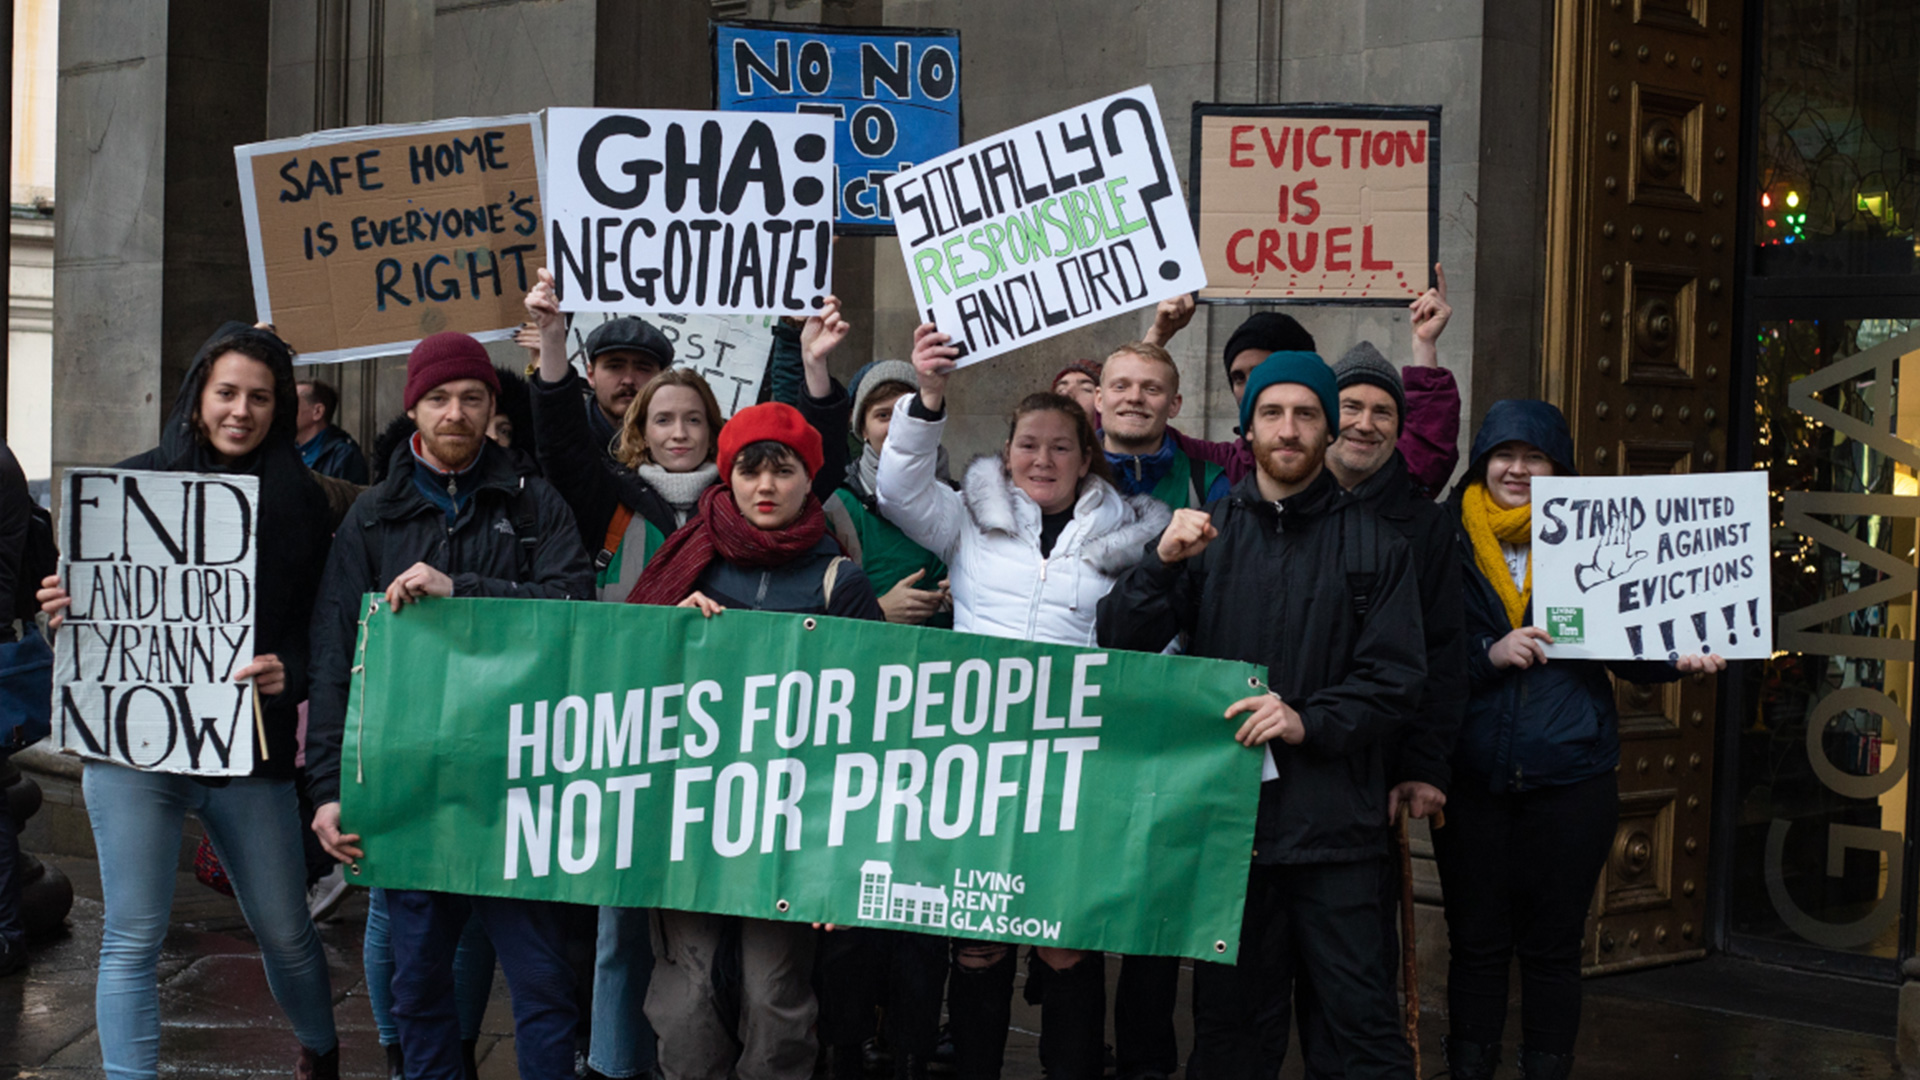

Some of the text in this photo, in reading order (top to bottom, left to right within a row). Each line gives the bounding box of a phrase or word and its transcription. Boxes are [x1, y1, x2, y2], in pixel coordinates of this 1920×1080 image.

[733, 39, 955, 100] NO NO
[279, 131, 509, 202] SAFE HOME
[577, 115, 827, 215] GHA:
[895, 113, 1105, 247] SOCIALLY
[1229, 125, 1426, 172] EVICTION
[303, 191, 538, 260] IS EVERYONE'S
[1278, 178, 1320, 225] IS
[552, 217, 830, 310] NEGOTIATE!
[914, 176, 1147, 305] RESPONSIBLE
[375, 243, 537, 310] RIGHT
[69, 474, 250, 565] END
[1539, 496, 1734, 545] STAND UNITED
[1657, 522, 1751, 564] AGAINST
[64, 564, 250, 624] LANDLORD
[1618, 555, 1753, 613] EVICTIONS
[60, 623, 251, 684] TYRANNY
[60, 683, 248, 769] NOW
[507, 652, 1109, 780] HOMES FOR PEOPLE
[503, 735, 1099, 880] NOT FOR PROFIT
[952, 889, 1013, 913] RENT
[954, 868, 1025, 894] LIVING
[950, 911, 1062, 940] GLASGOW
